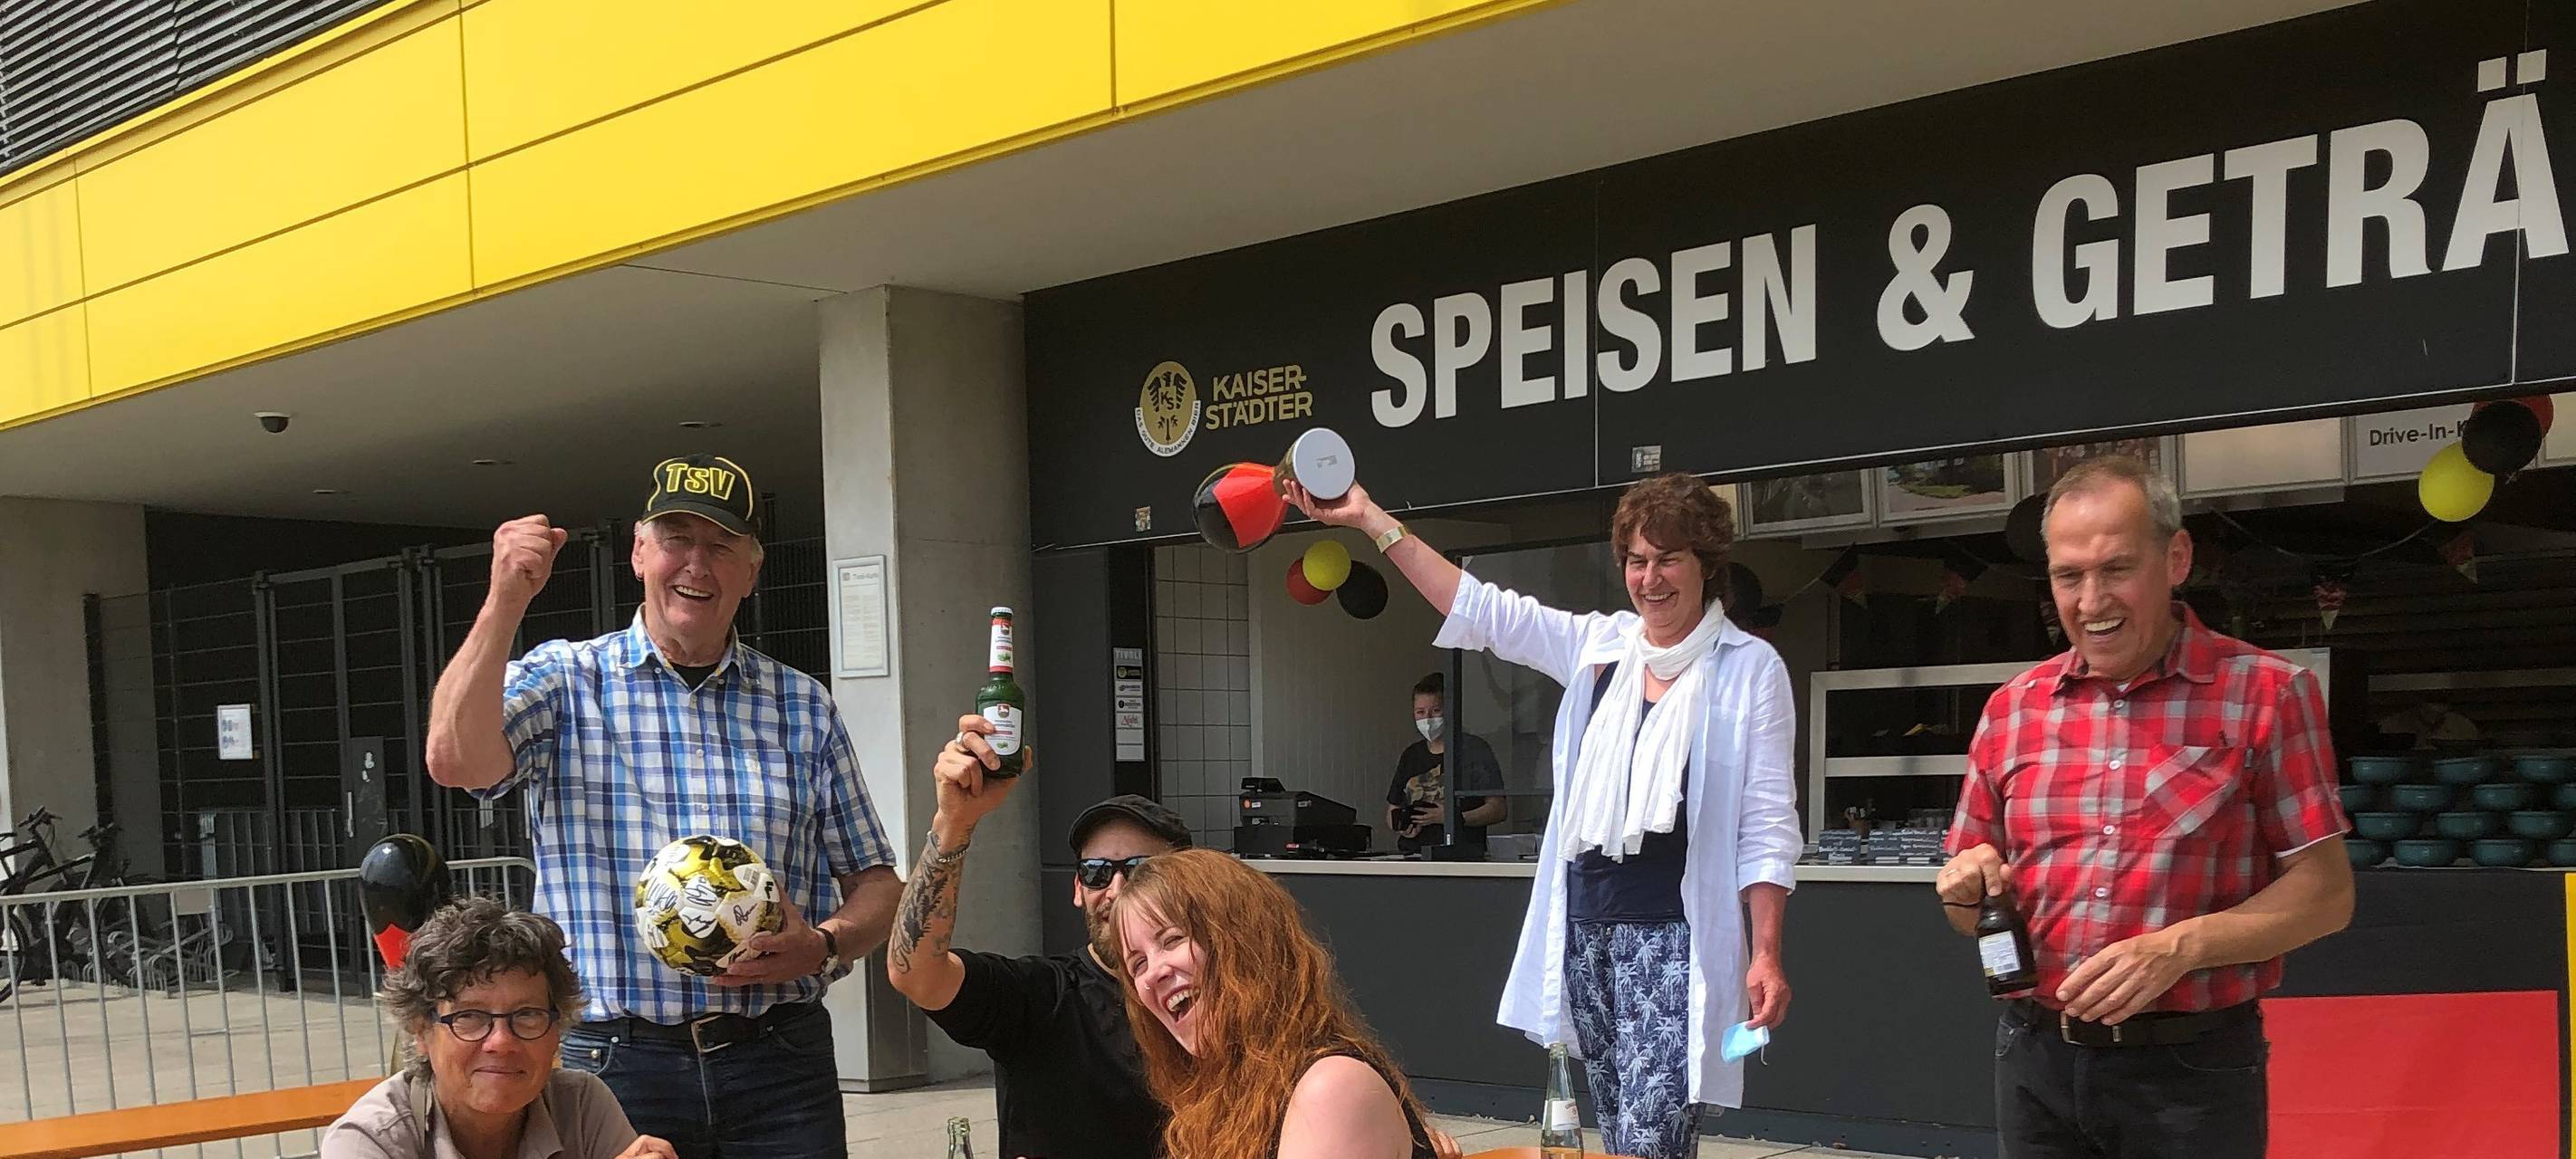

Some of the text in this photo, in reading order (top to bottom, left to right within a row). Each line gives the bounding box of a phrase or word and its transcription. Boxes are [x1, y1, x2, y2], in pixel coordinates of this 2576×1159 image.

[1370, 48, 2570, 428] SPEISEN & GETRÄ
[1160, 390, 1175, 410] KS
[1213, 364, 1307, 401] KAISER-
[1205, 390, 1313, 430] STÄDTER
[666, 463, 735, 500] TSV
